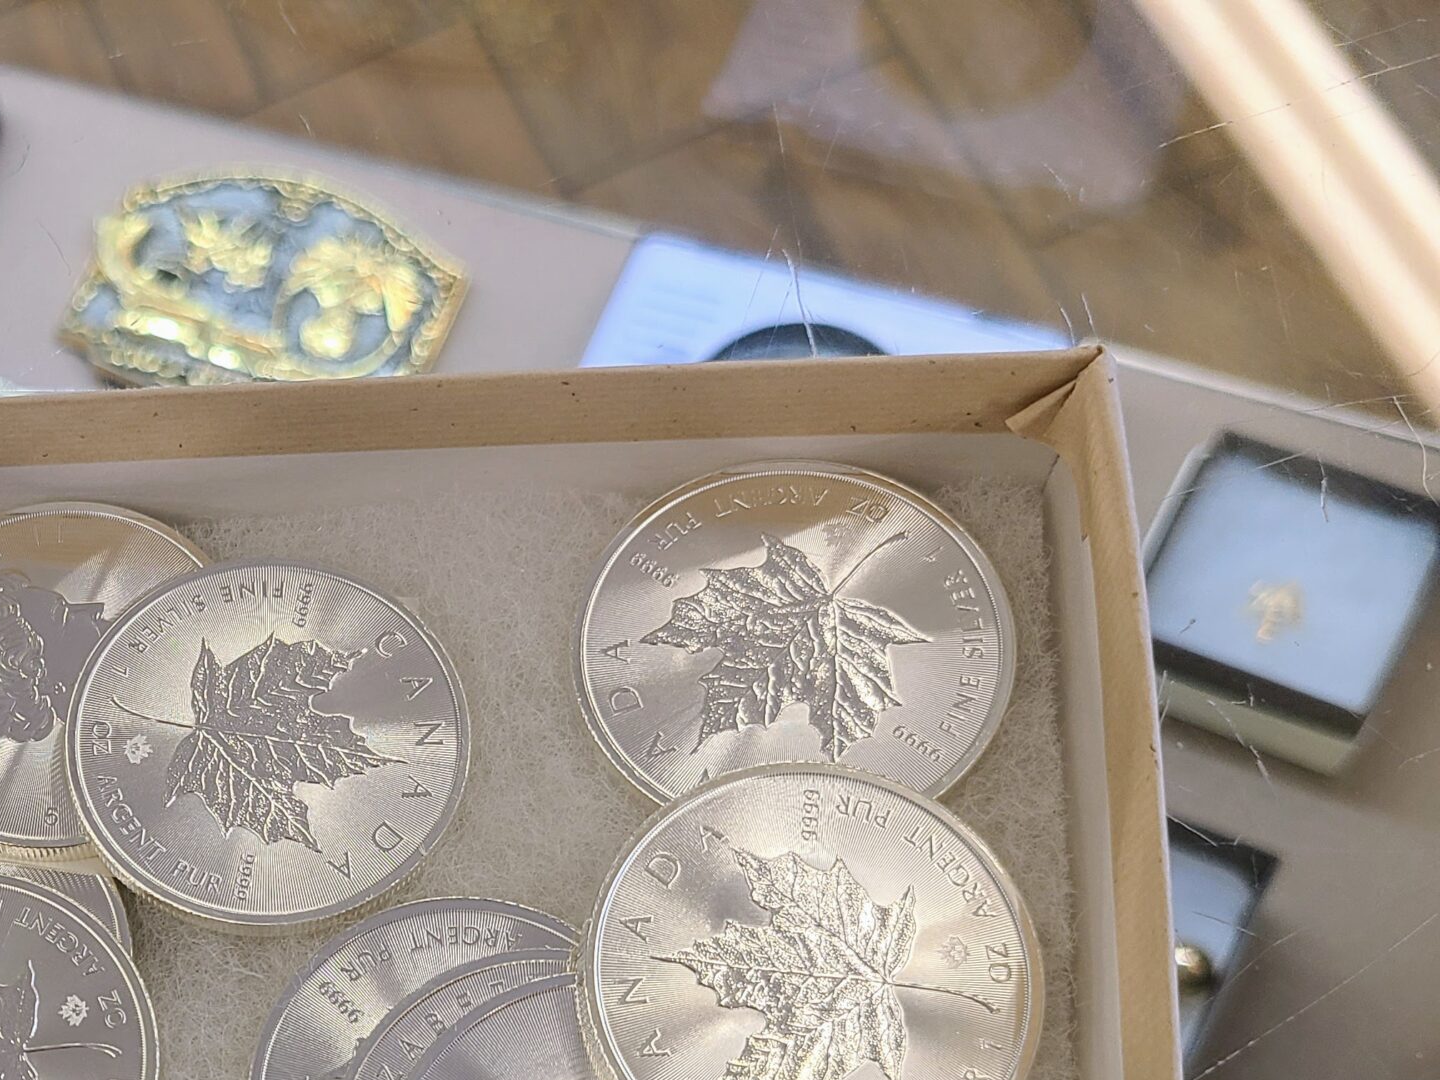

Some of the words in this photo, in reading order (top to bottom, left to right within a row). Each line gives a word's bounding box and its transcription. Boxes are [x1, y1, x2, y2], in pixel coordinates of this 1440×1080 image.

[222, 580, 285, 605] FINE
[292, 582, 316, 629] 9999
[943, 569, 986, 661] SILVER
[127, 594, 207, 655] SILVER
[938, 675, 982, 738] FINE
[327, 630, 446, 880] CANADA
[44, 806, 59, 827] 5
[96, 774, 168, 870] ARGENT
[835, 793, 891, 830] PUR
[172, 861, 222, 892] PUR
[235, 852, 256, 901] 9999
[904, 825, 996, 918] ARGENT
[13, 906, 106, 978] ARGENT
[340, 943, 392, 982] PUR
[986, 941, 1013, 984] OZ
